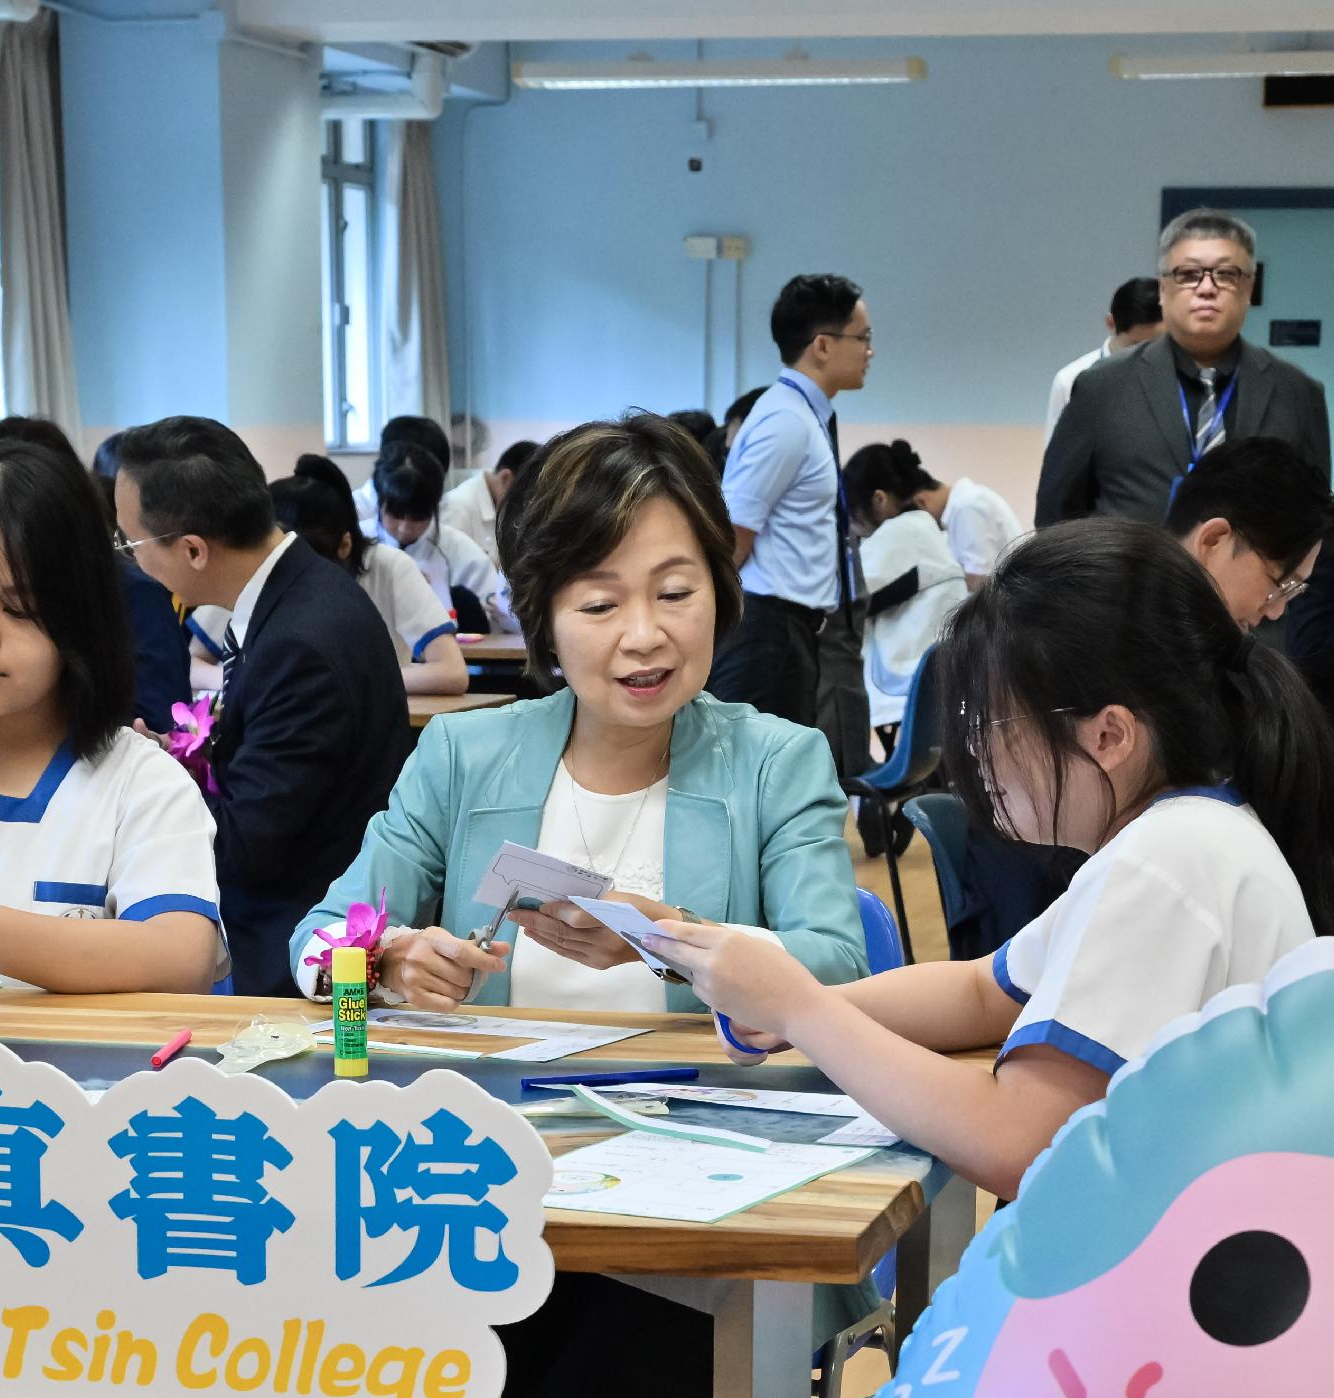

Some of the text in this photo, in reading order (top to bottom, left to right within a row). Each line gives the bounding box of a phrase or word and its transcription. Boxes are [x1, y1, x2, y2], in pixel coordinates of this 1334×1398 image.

[338, 997, 365, 1009] Glue
[338, 1009, 366, 1022] Stick
[0, 1303, 158, 1386] Tsin
